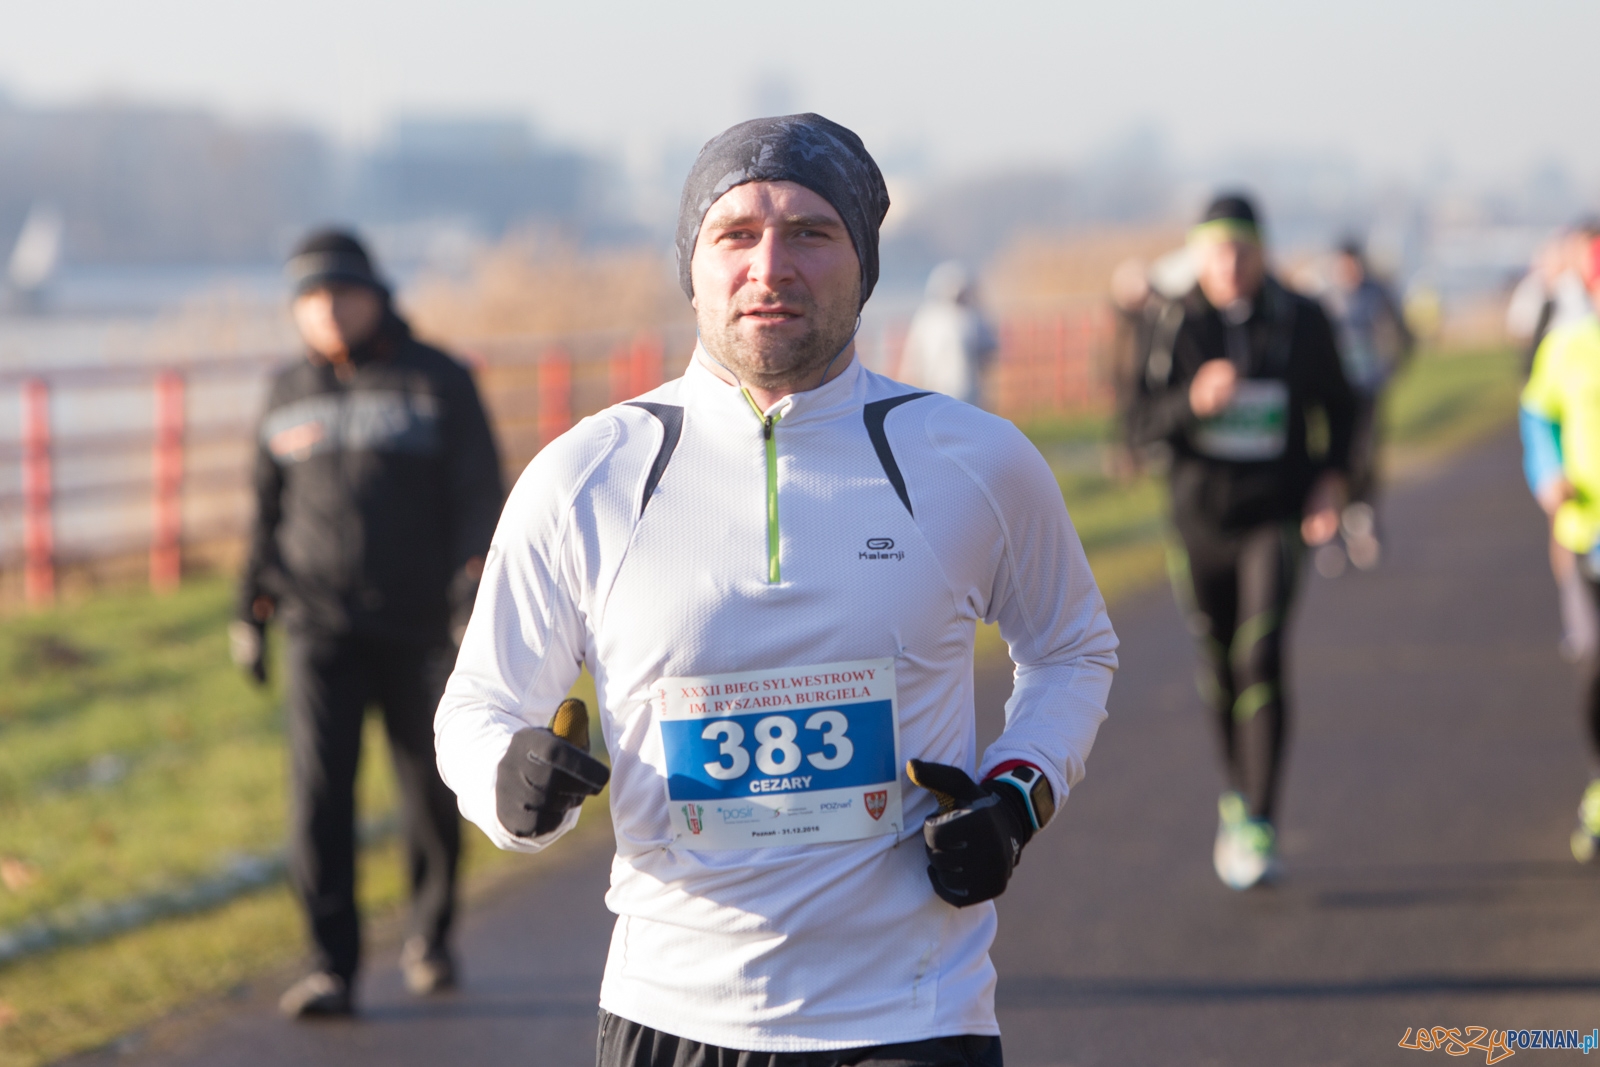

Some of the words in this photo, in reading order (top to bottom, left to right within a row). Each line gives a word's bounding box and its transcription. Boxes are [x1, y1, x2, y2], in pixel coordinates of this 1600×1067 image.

[858, 551, 905, 561] Kalenji
[681, 685, 721, 699] XXXII
[724, 681, 759, 696] BIEG
[762, 669, 876, 692] SYLWESTROWY
[689, 702, 711, 714] IM.
[714, 696, 792, 713] RYSZARDA
[795, 686, 872, 705] BURGIELA
[701, 710, 854, 780] 383
[749, 776, 812, 793] CEZARY
